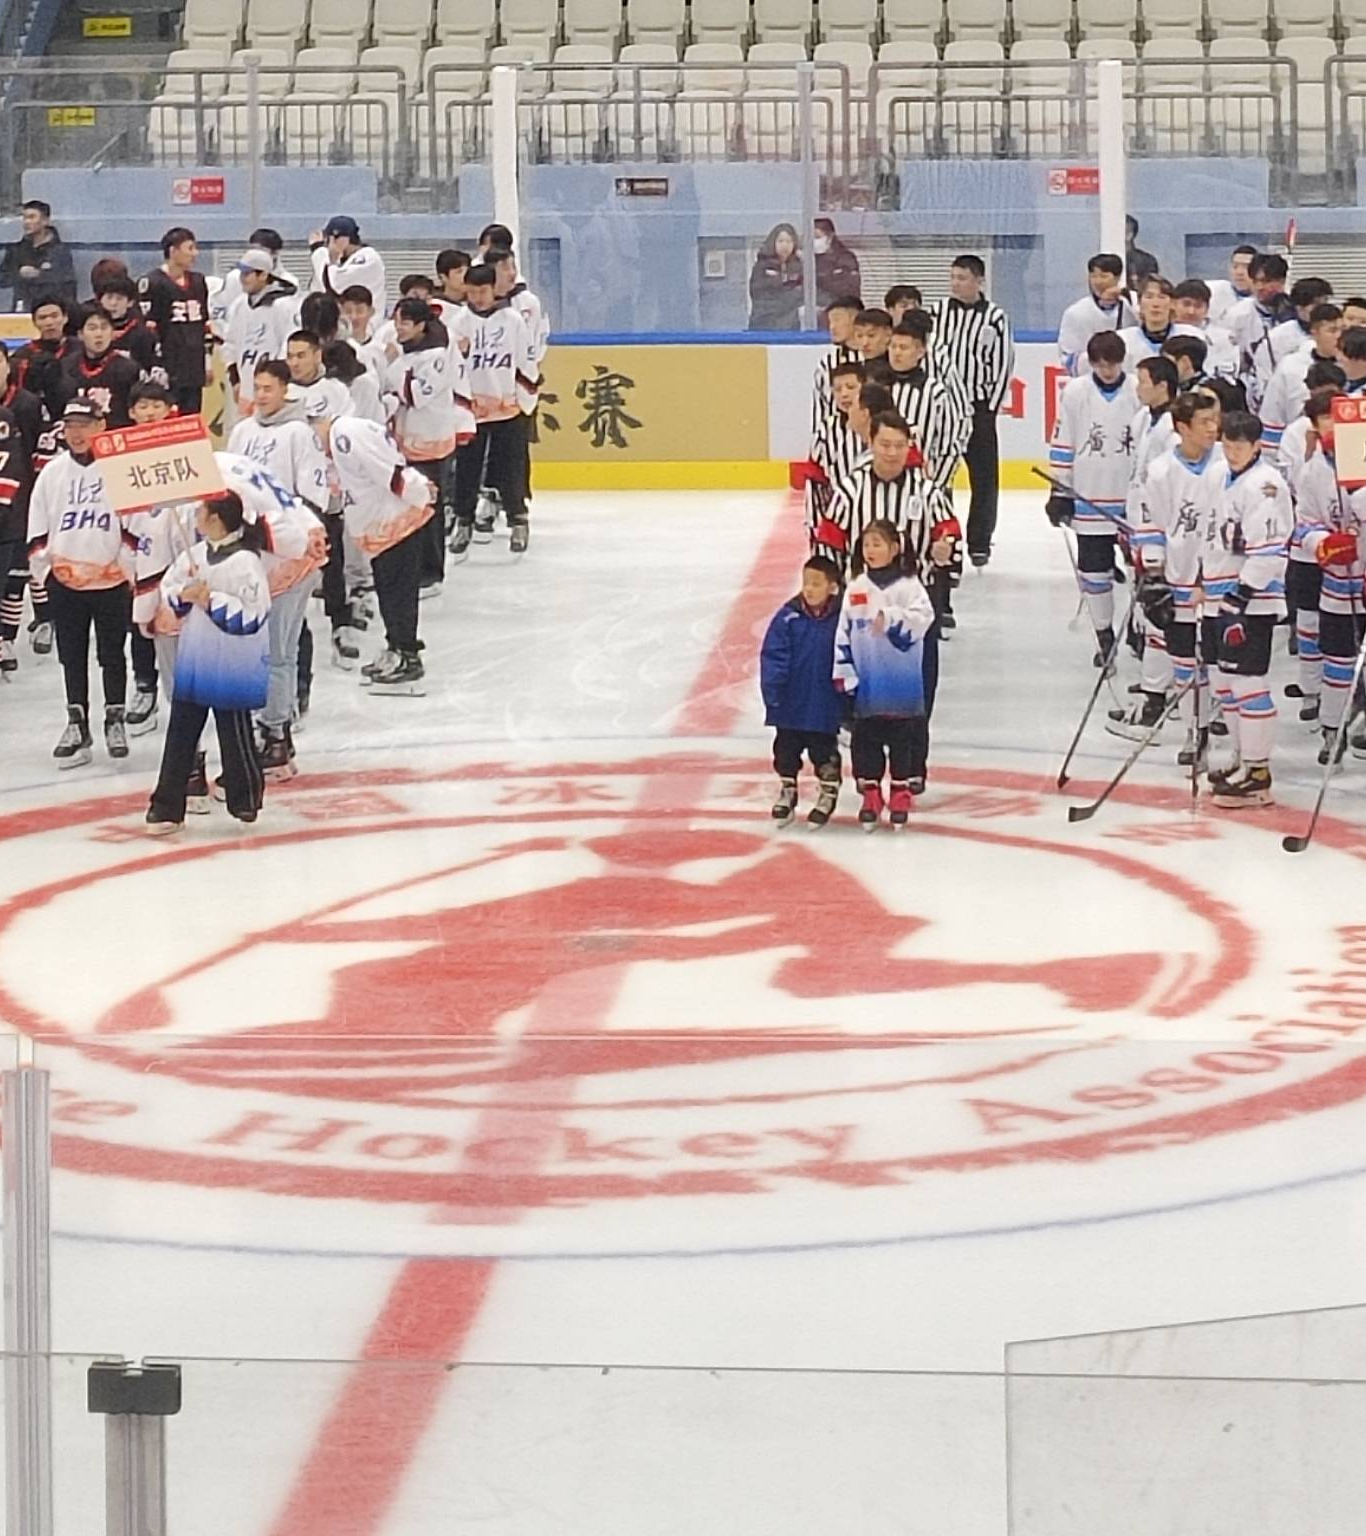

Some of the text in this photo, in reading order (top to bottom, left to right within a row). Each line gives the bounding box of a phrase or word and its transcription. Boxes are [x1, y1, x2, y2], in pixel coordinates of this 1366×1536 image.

[127, 455, 199, 489] 北京队
[206, 1110, 860, 1173] Hockey
